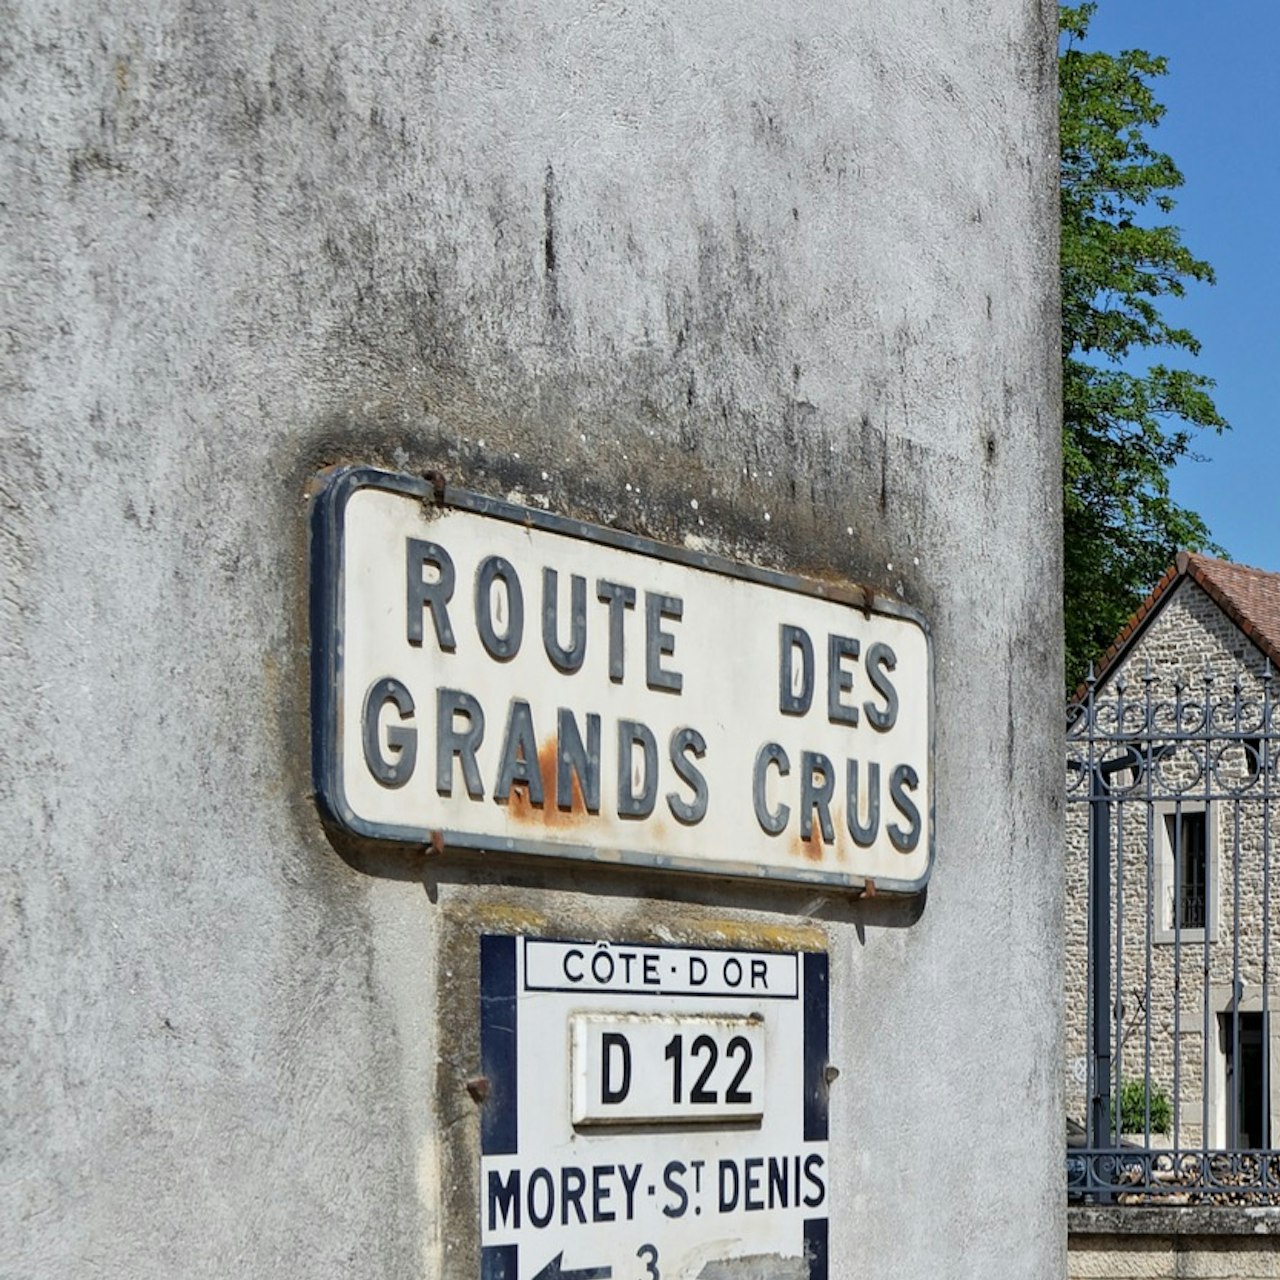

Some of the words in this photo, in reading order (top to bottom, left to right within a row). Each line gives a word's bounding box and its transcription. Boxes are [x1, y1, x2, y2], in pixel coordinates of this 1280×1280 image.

[406, 537, 684, 695] ROUTE
[778, 624, 899, 733] DES
[362, 677, 708, 825] GRANDS
[752, 742, 922, 853] CRUS
[601, 1033, 632, 1105] D
[664, 1034, 753, 1105] 122
[718, 1153, 826, 1213] DENIS
